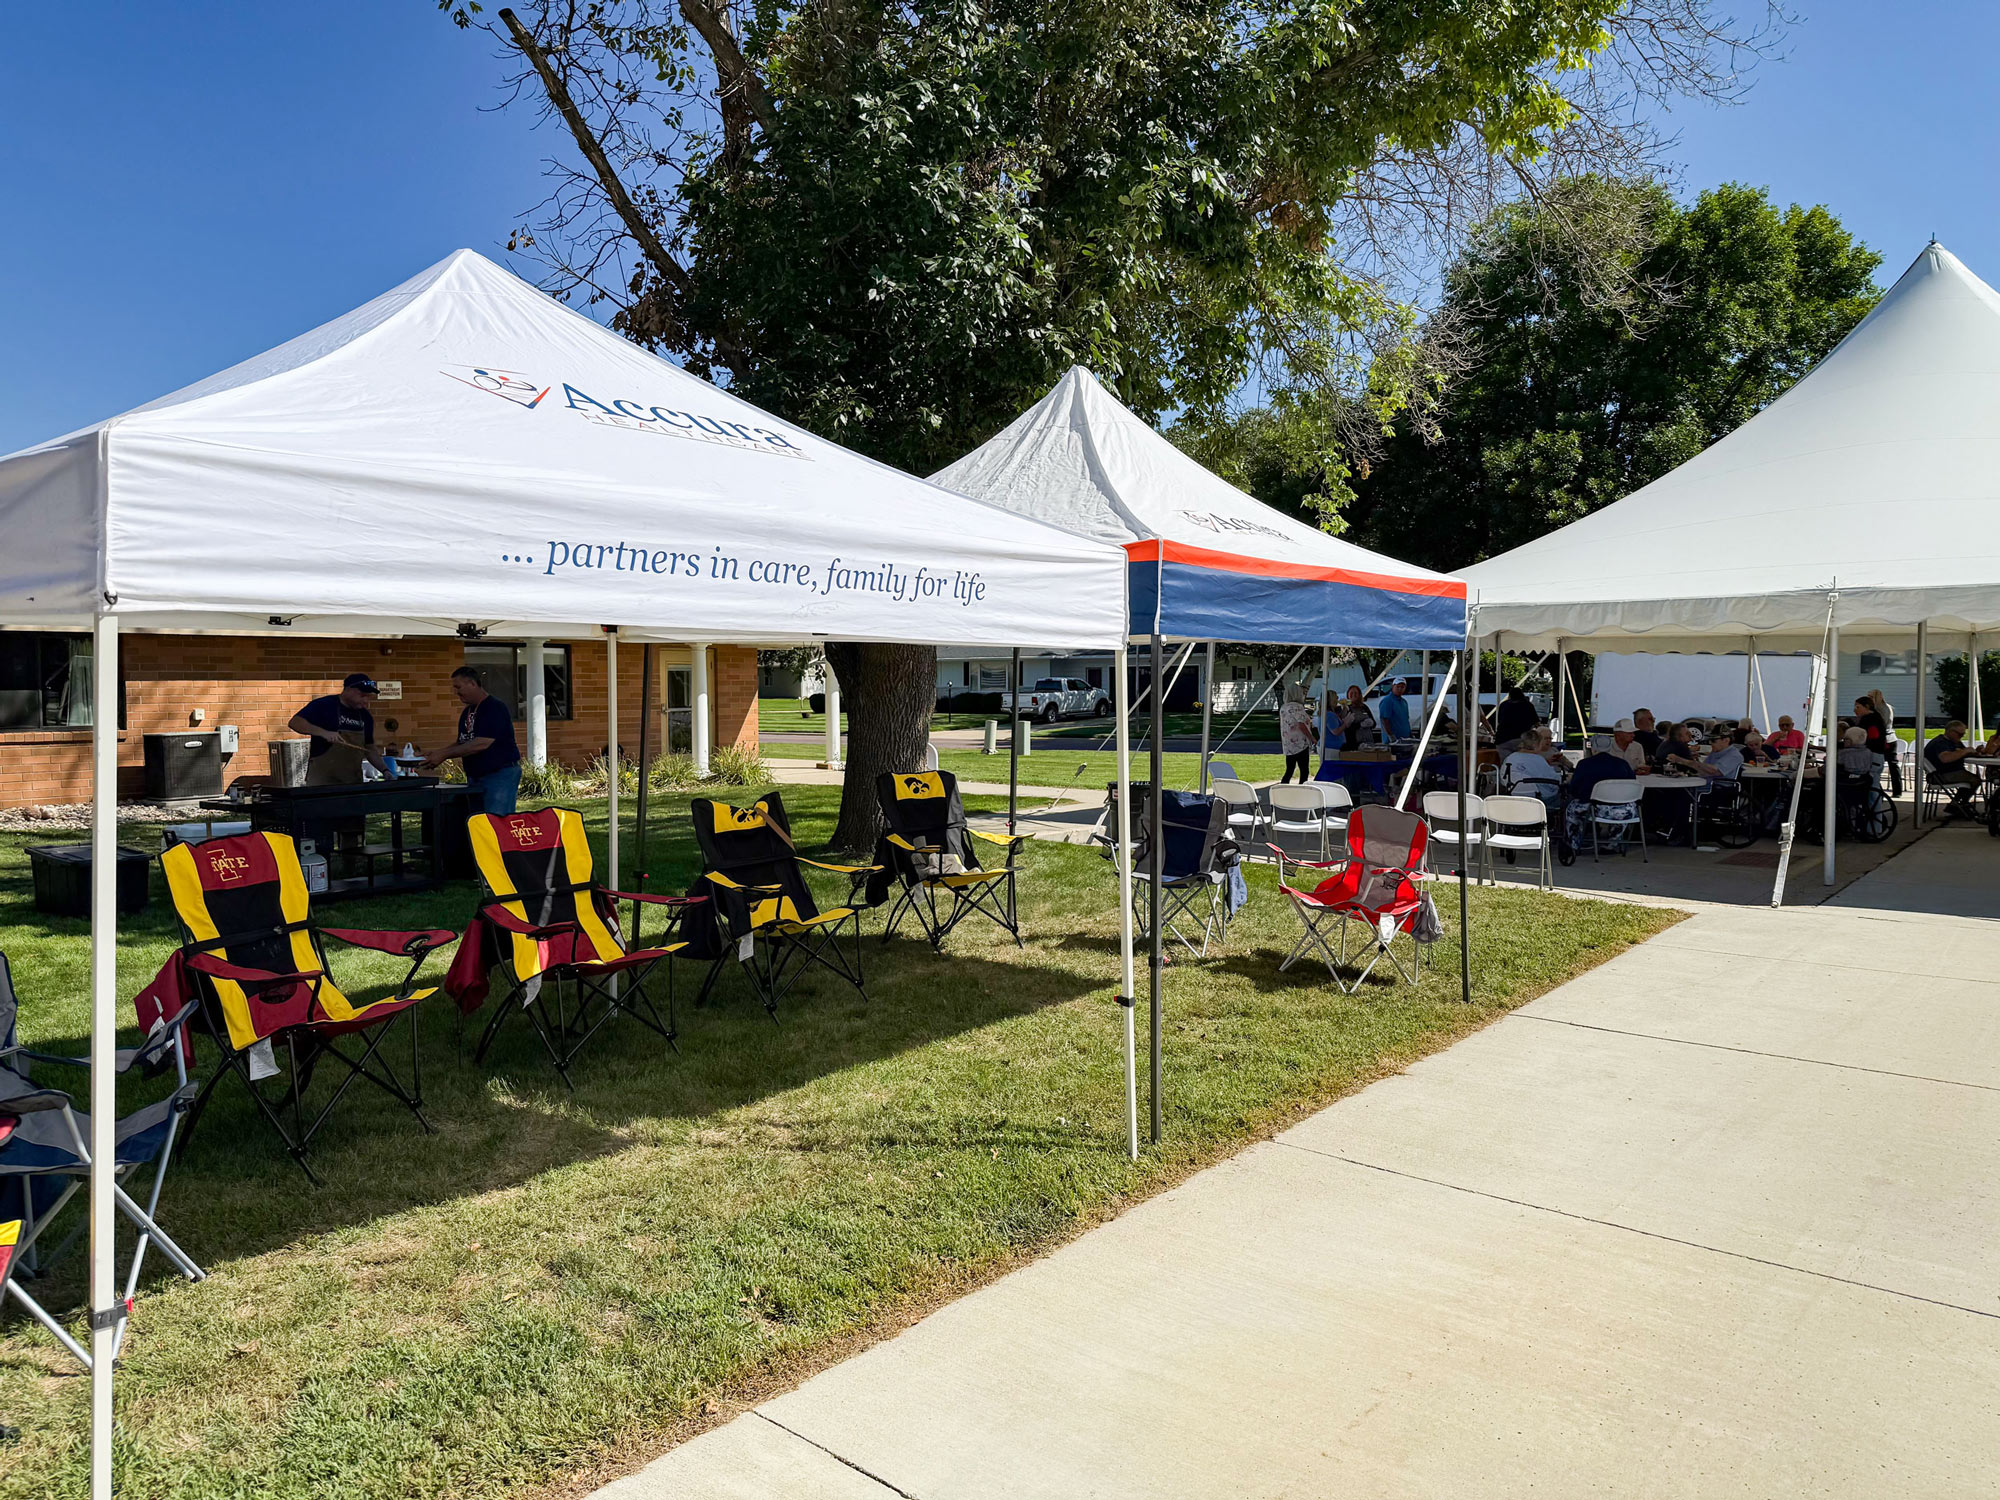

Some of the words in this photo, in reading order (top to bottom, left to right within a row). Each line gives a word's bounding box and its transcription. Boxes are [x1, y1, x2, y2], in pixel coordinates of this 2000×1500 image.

[562, 383, 802, 450] Accura
[543, 539, 700, 577] partners
[710, 546, 740, 580] in
[748, 559, 817, 593] care,
[820, 558, 907, 601] family
[909, 567, 948, 602] for
[953, 571, 986, 606] life
